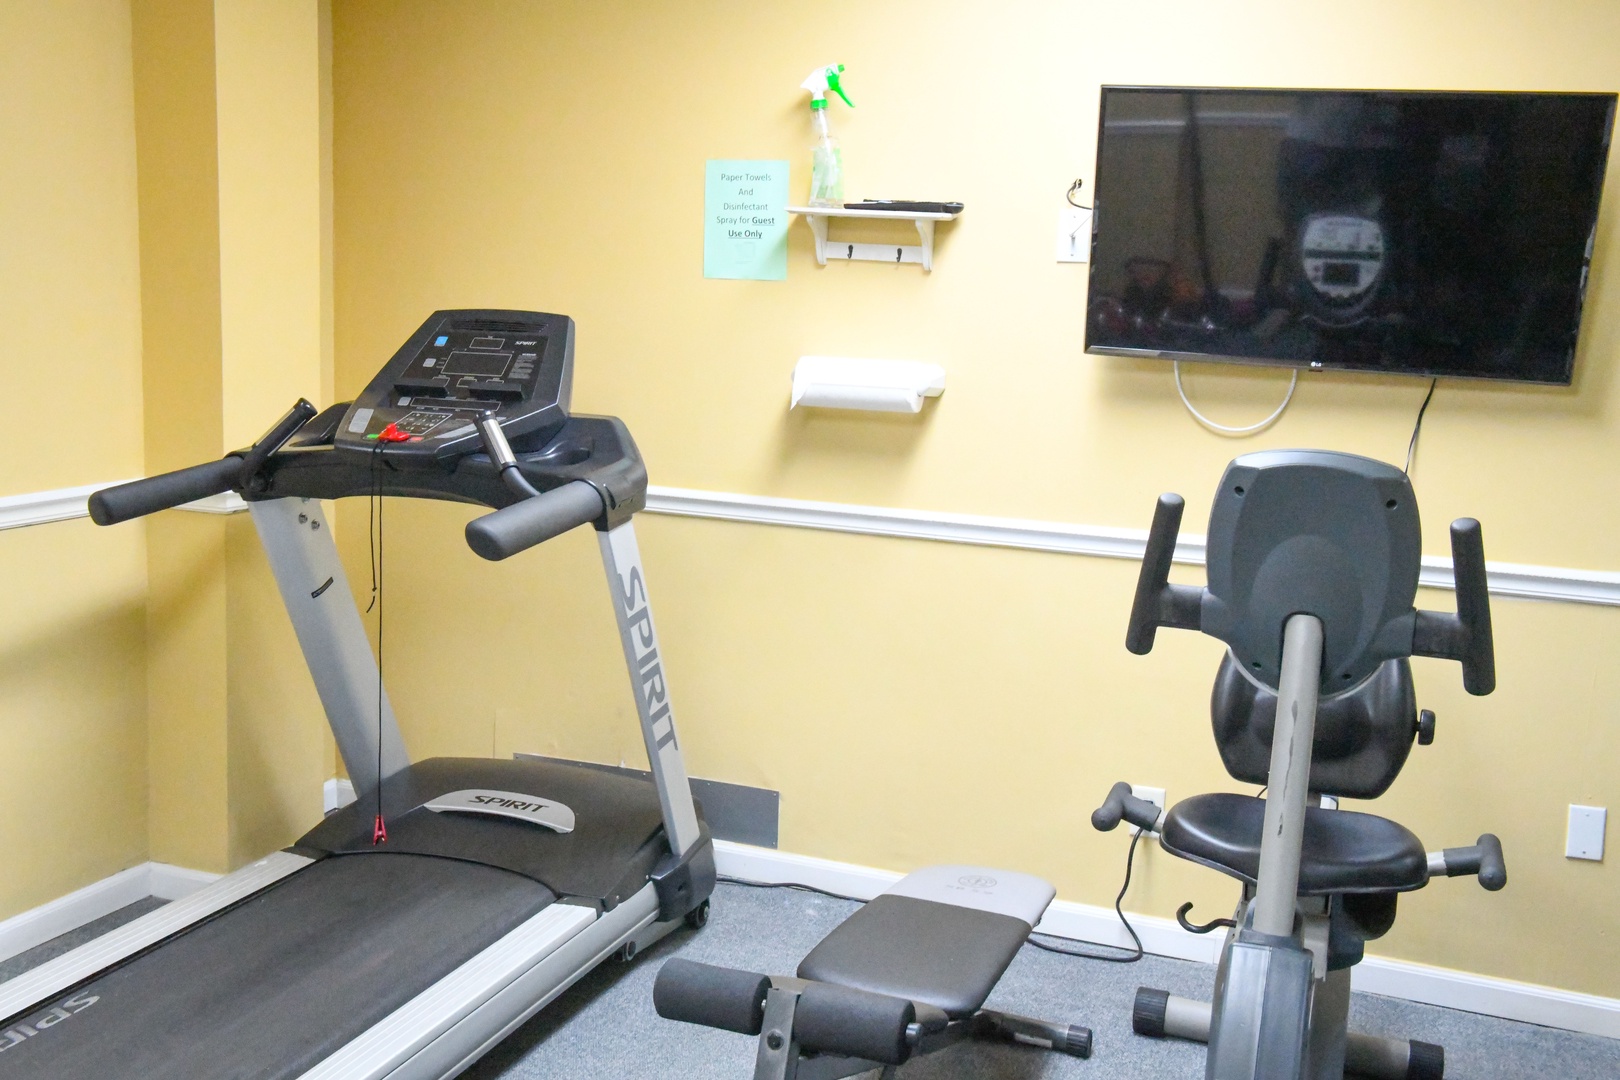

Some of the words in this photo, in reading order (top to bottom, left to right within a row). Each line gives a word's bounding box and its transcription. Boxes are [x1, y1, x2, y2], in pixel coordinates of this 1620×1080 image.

[721, 173, 743, 183] Paper
[745, 173, 772, 182] Towels
[738, 188, 754, 196] And
[723, 202, 768, 211] Disinfectant
[716, 216, 738, 225] Spray
[739, 216, 750, 224] for
[752, 216, 775, 225] Guest
[728, 230, 743, 238] Use
[744, 230, 763, 239] Only
[617, 565, 679, 751] SPIRIT
[468, 795, 549, 812] SPIRIT
